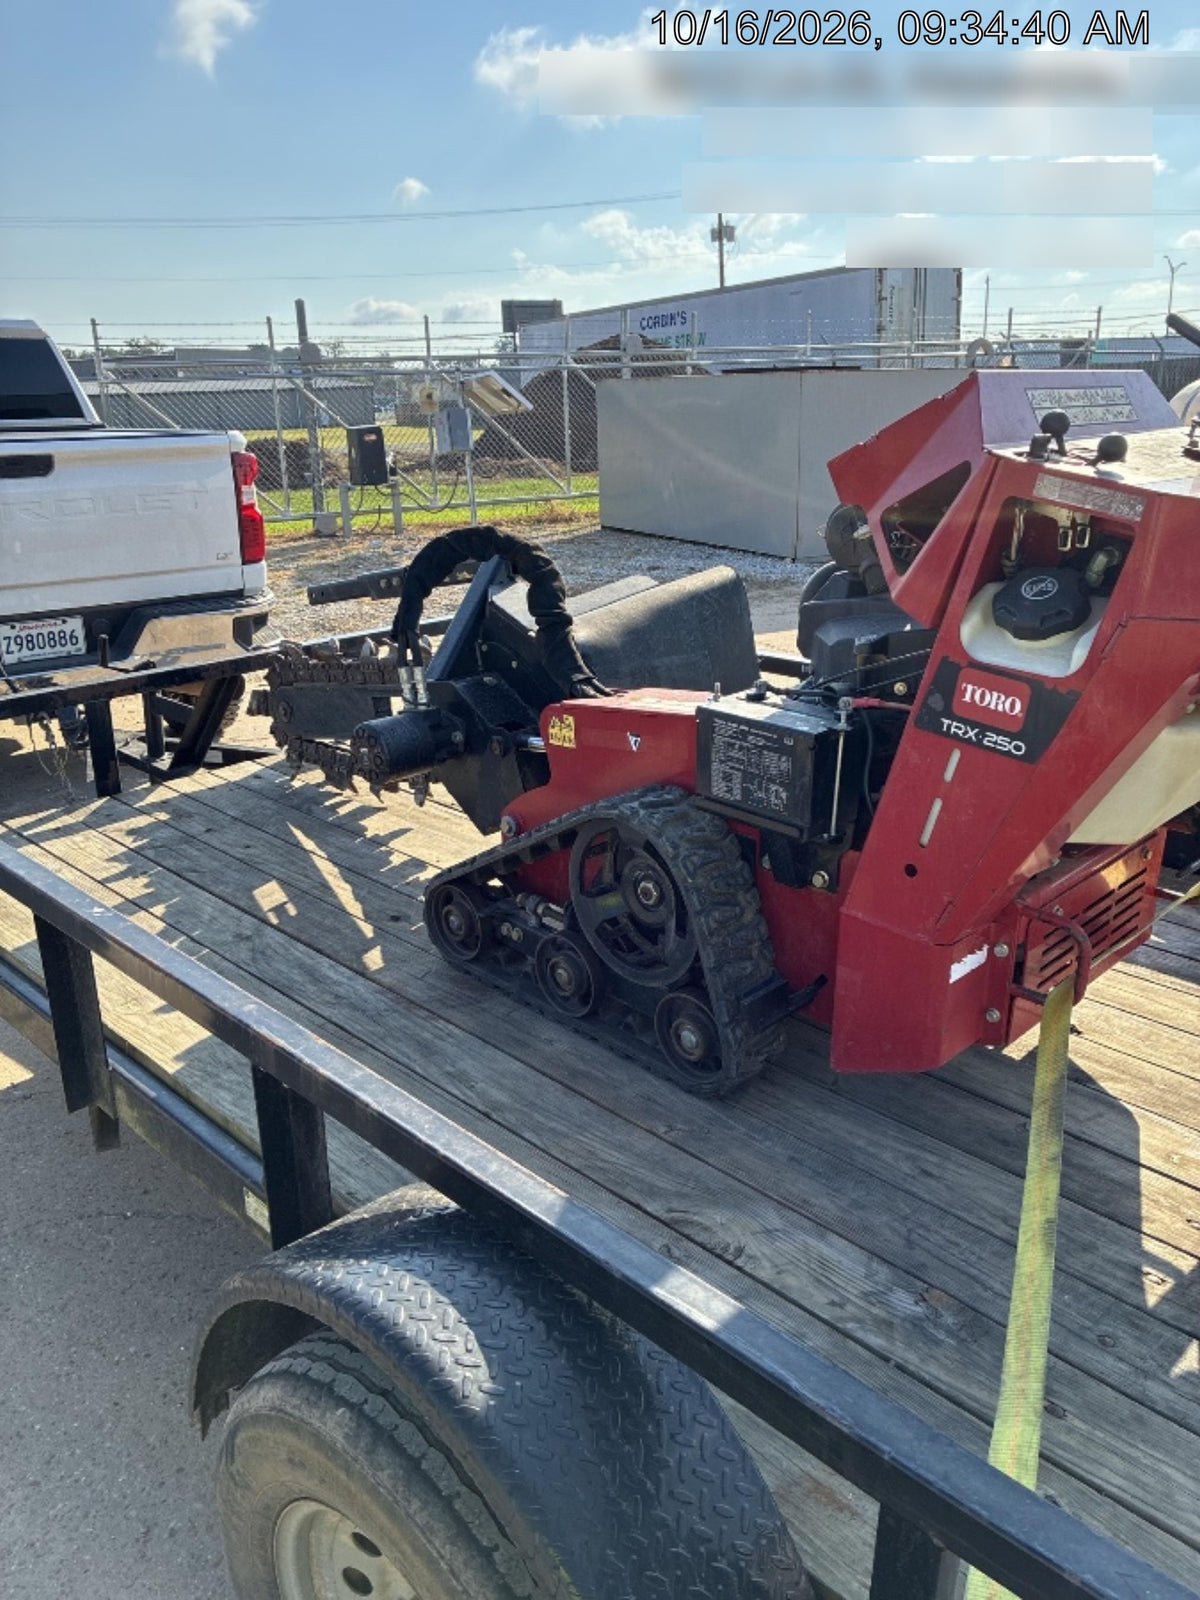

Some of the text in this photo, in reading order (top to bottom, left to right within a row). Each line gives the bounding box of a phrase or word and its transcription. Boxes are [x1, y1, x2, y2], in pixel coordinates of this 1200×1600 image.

[640, 310, 688, 331] CORBIN'S
[3, 629, 79, 655] Z980886
[961, 682, 1023, 717] TORO
